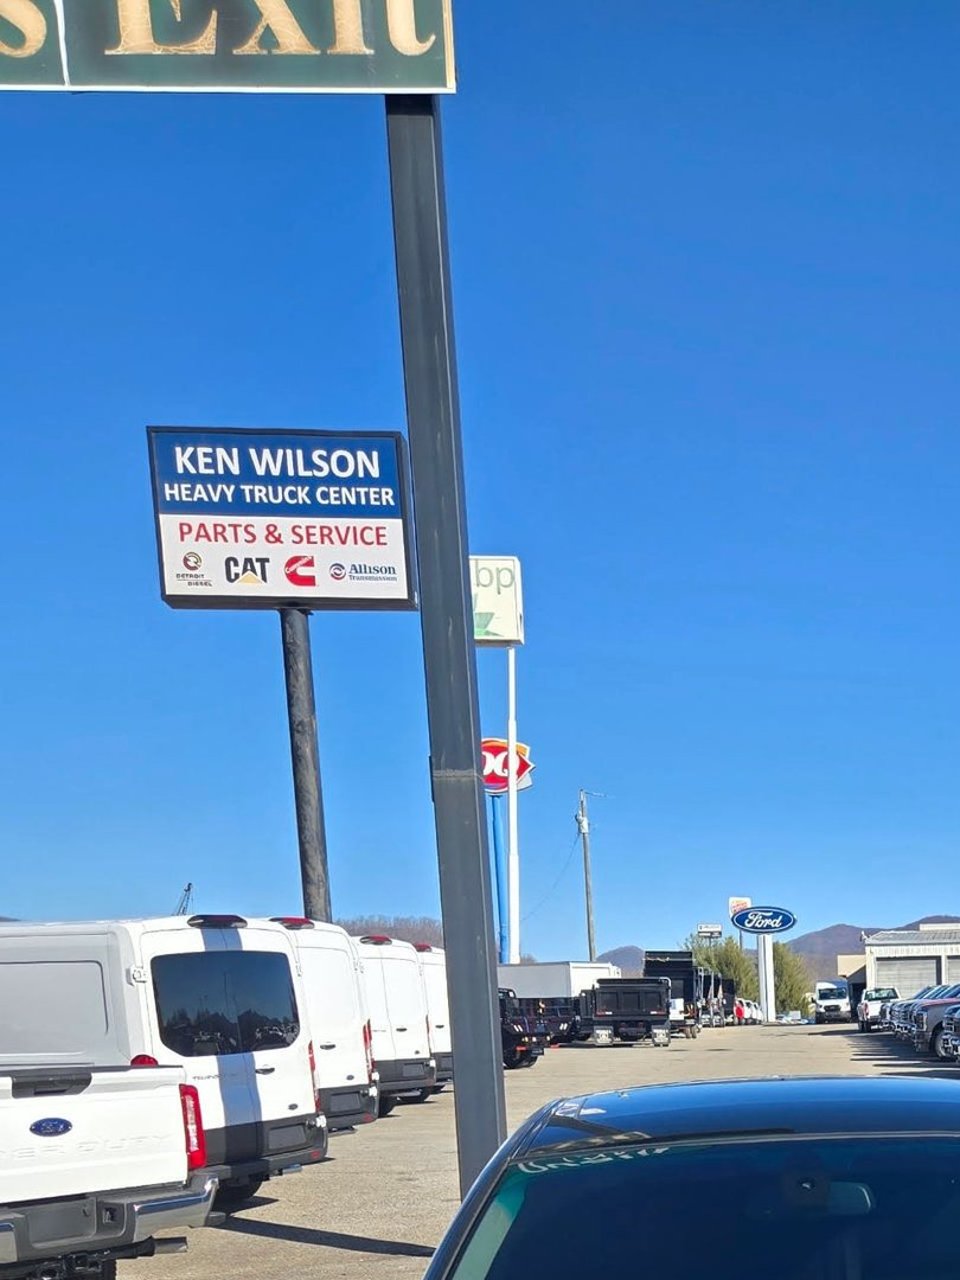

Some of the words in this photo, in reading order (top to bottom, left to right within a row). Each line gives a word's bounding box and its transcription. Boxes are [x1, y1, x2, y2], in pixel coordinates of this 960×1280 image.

[175, 447, 240, 475] KEN
[249, 449, 380, 478] WILSON
[164, 484, 236, 503] HEAVY
[241, 485, 311, 505] TRUCK
[316, 487, 395, 506] CENTER
[179, 523, 256, 544] PARTS
[265, 524, 283, 545] &
[292, 525, 387, 546] SERVICE
[225, 556, 271, 583] CAT
[349, 564, 396, 575] Allison
[475, 560, 516, 595] bp
[744, 911, 783, 929] Ford
